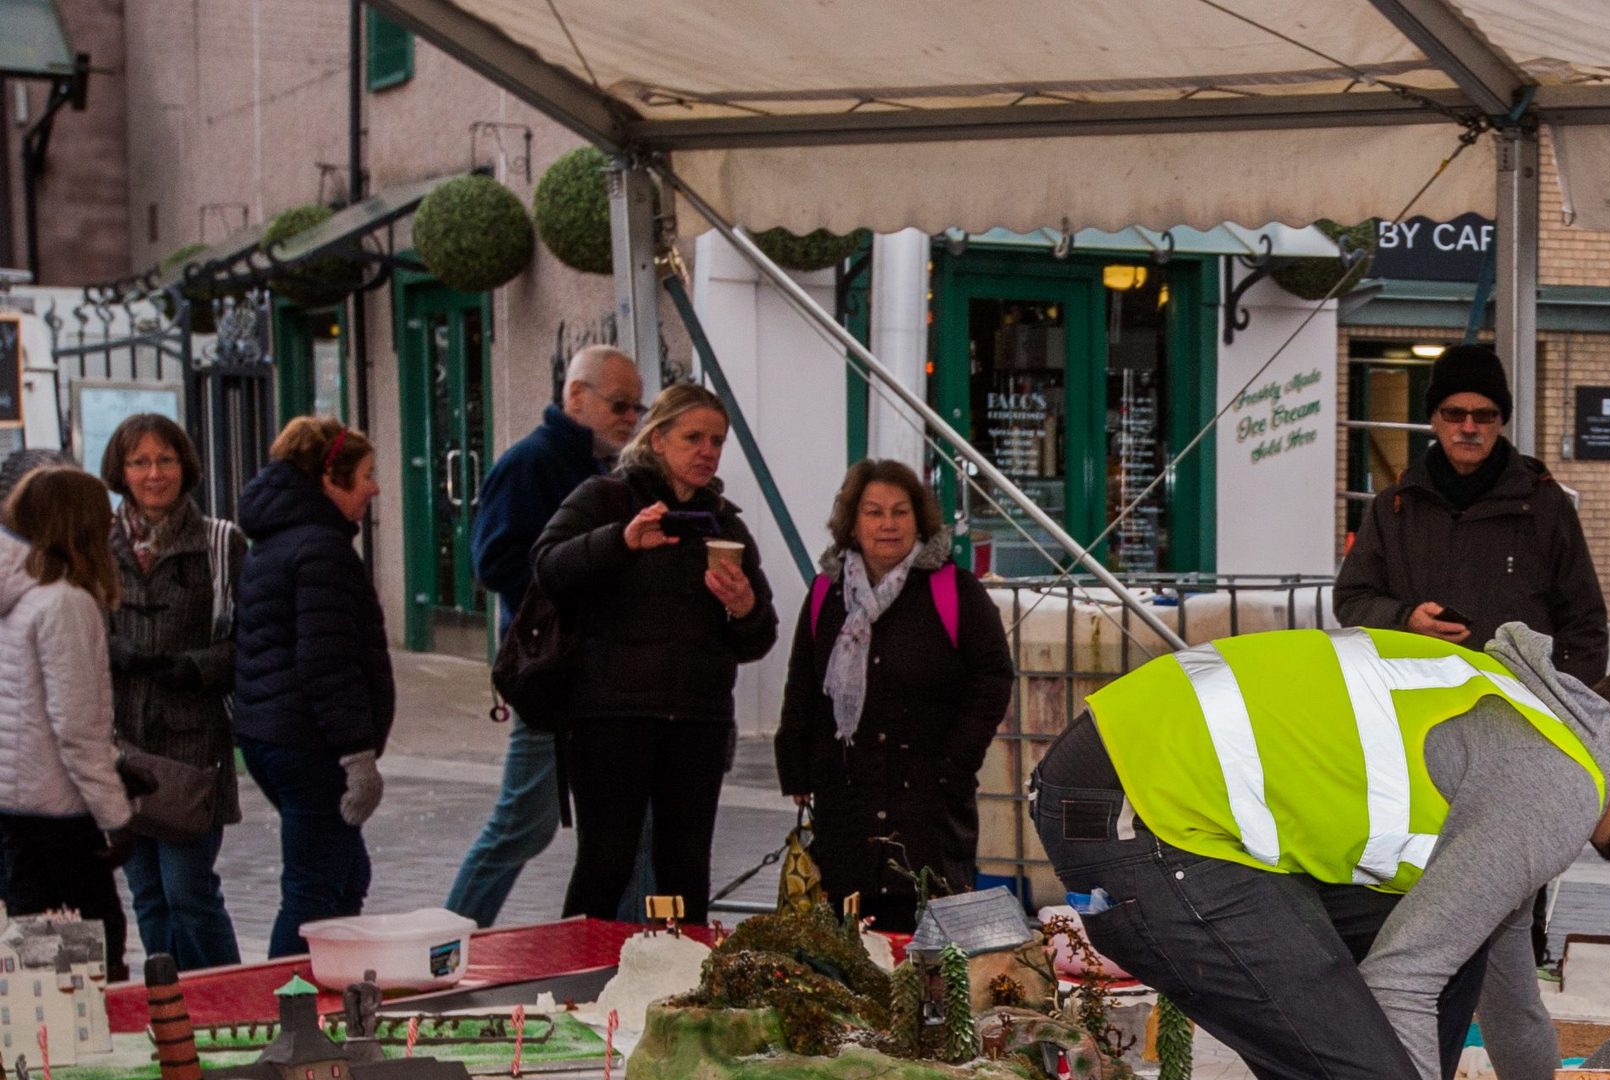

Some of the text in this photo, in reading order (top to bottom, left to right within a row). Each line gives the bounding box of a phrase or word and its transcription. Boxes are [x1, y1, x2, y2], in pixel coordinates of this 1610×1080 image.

[1379, 221, 1420, 249] BY
[1236, 399, 1320, 443] Ice Cream
[1283, 426, 1317, 451] Here
